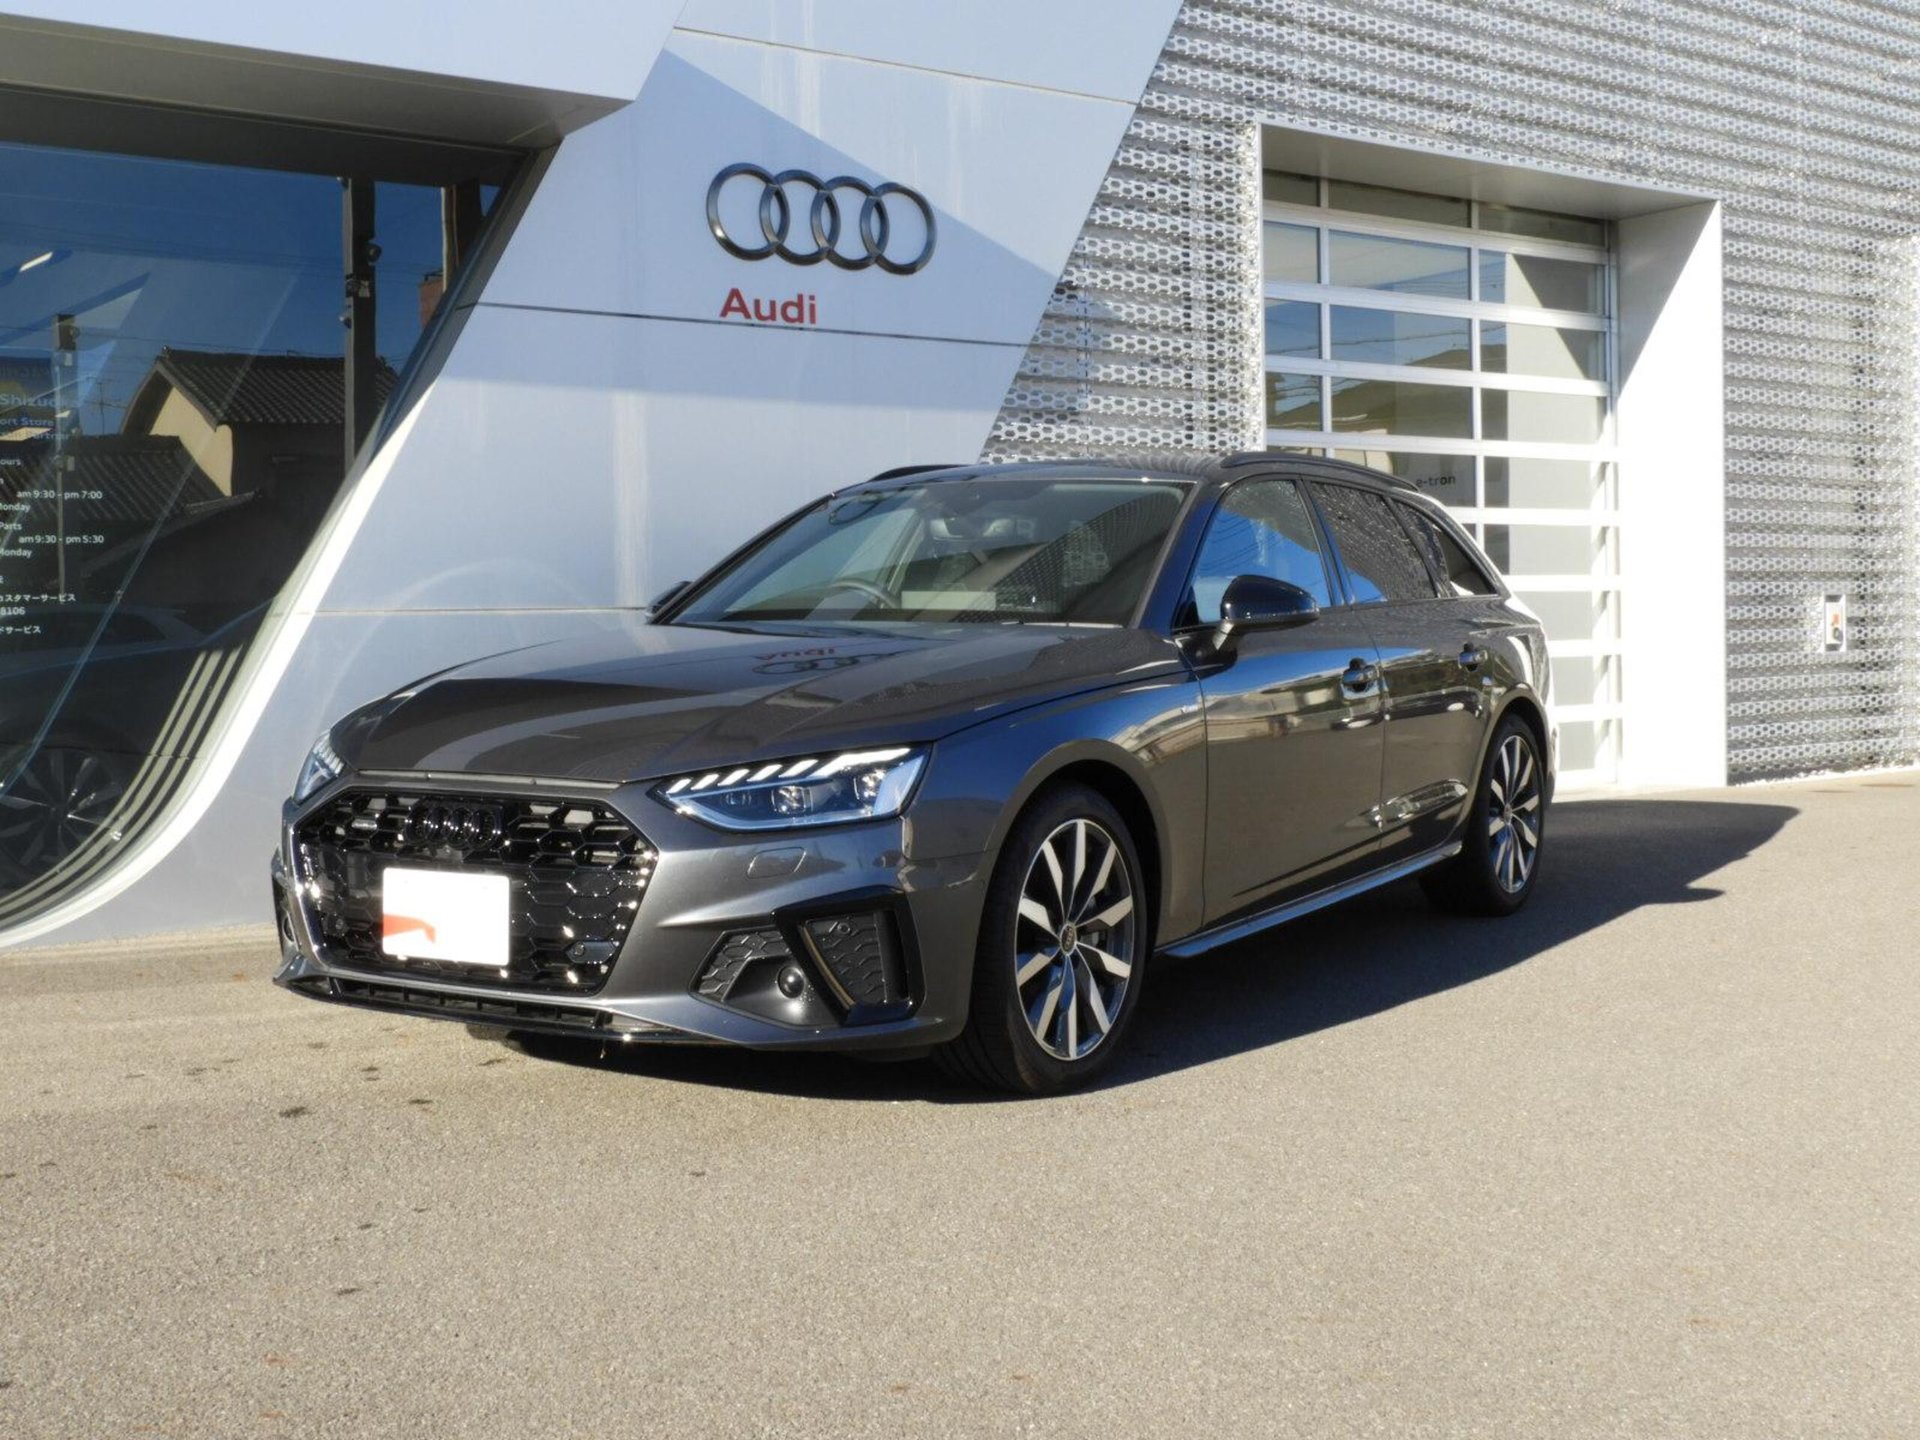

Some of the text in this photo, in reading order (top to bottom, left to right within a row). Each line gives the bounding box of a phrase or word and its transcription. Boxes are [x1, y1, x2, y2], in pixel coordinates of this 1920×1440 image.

[719, 287, 817, 325] Audi
[1416, 475, 1456, 488] e-tron
[33, 490, 56, 499] 9:30
[64, 492, 80, 501] pm
[81, 490, 103, 499] 7:00
[19, 536, 34, 544] am
[35, 535, 57, 544] 9:30
[65, 536, 81, 545] pm
[82, 535, 104, 544] 5:30
